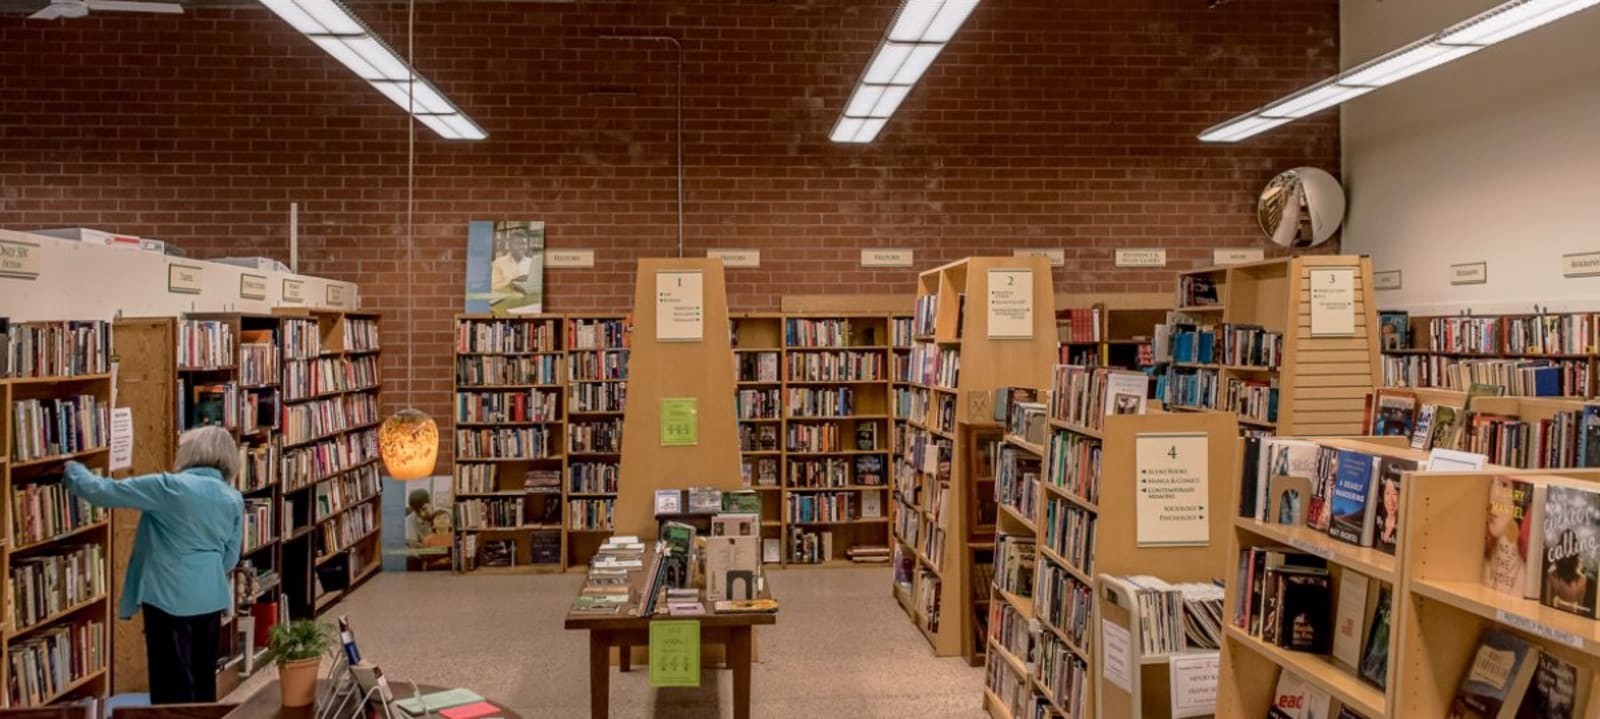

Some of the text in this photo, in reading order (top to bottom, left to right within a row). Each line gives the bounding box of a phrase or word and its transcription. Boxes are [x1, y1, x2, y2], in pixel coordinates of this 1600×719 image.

[1008, 275, 1015, 286] 2
[1328, 274, 1336, 284] 3
[1167, 445, 1177, 459] 4
